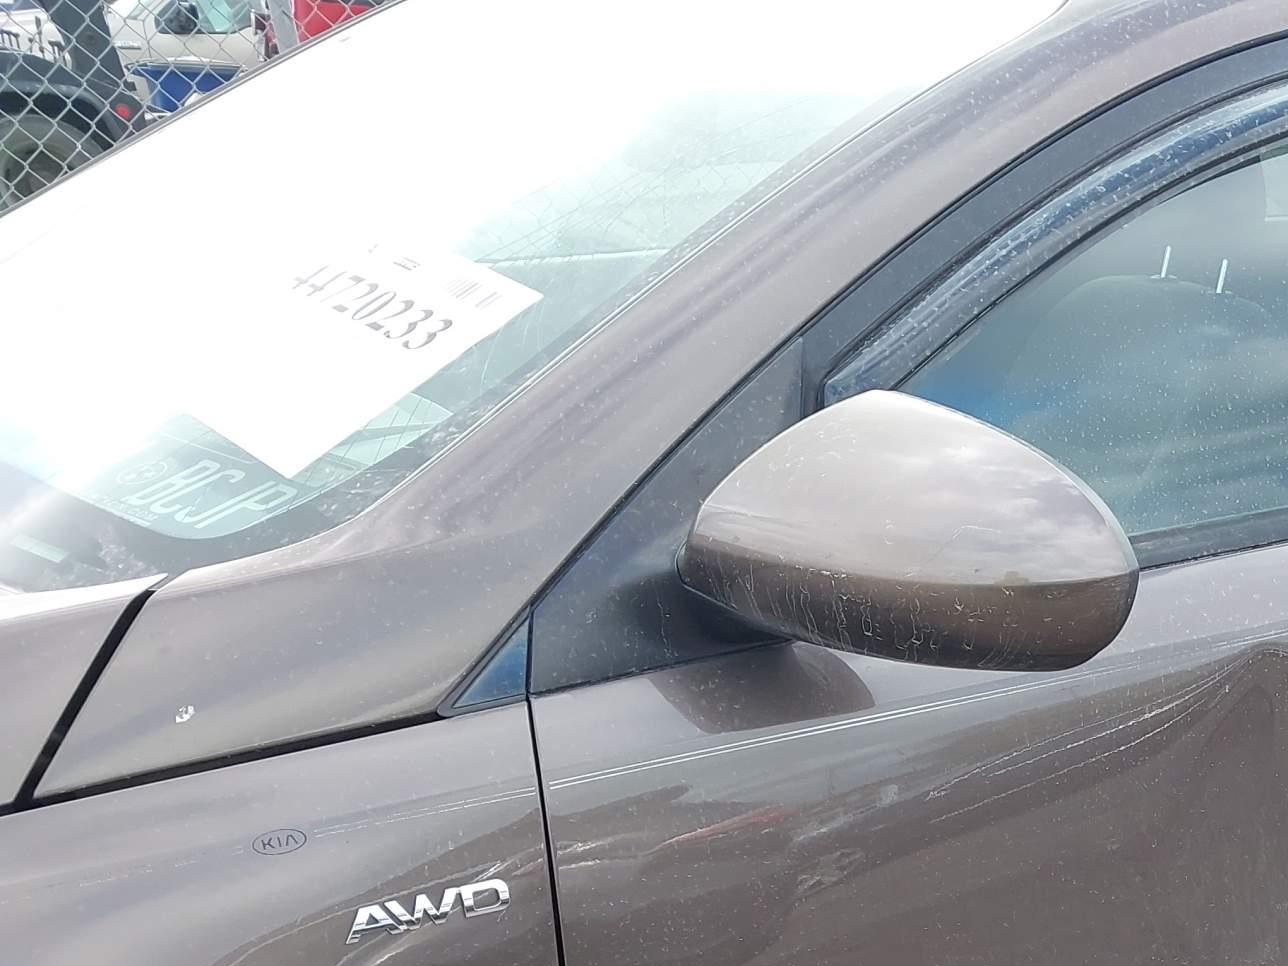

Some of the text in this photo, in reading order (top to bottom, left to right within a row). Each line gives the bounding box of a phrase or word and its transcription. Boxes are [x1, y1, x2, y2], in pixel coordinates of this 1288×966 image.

[291, 264, 454, 350] 44720233
[259, 832, 300, 852] KIA
[345, 878, 511, 944] AWD
